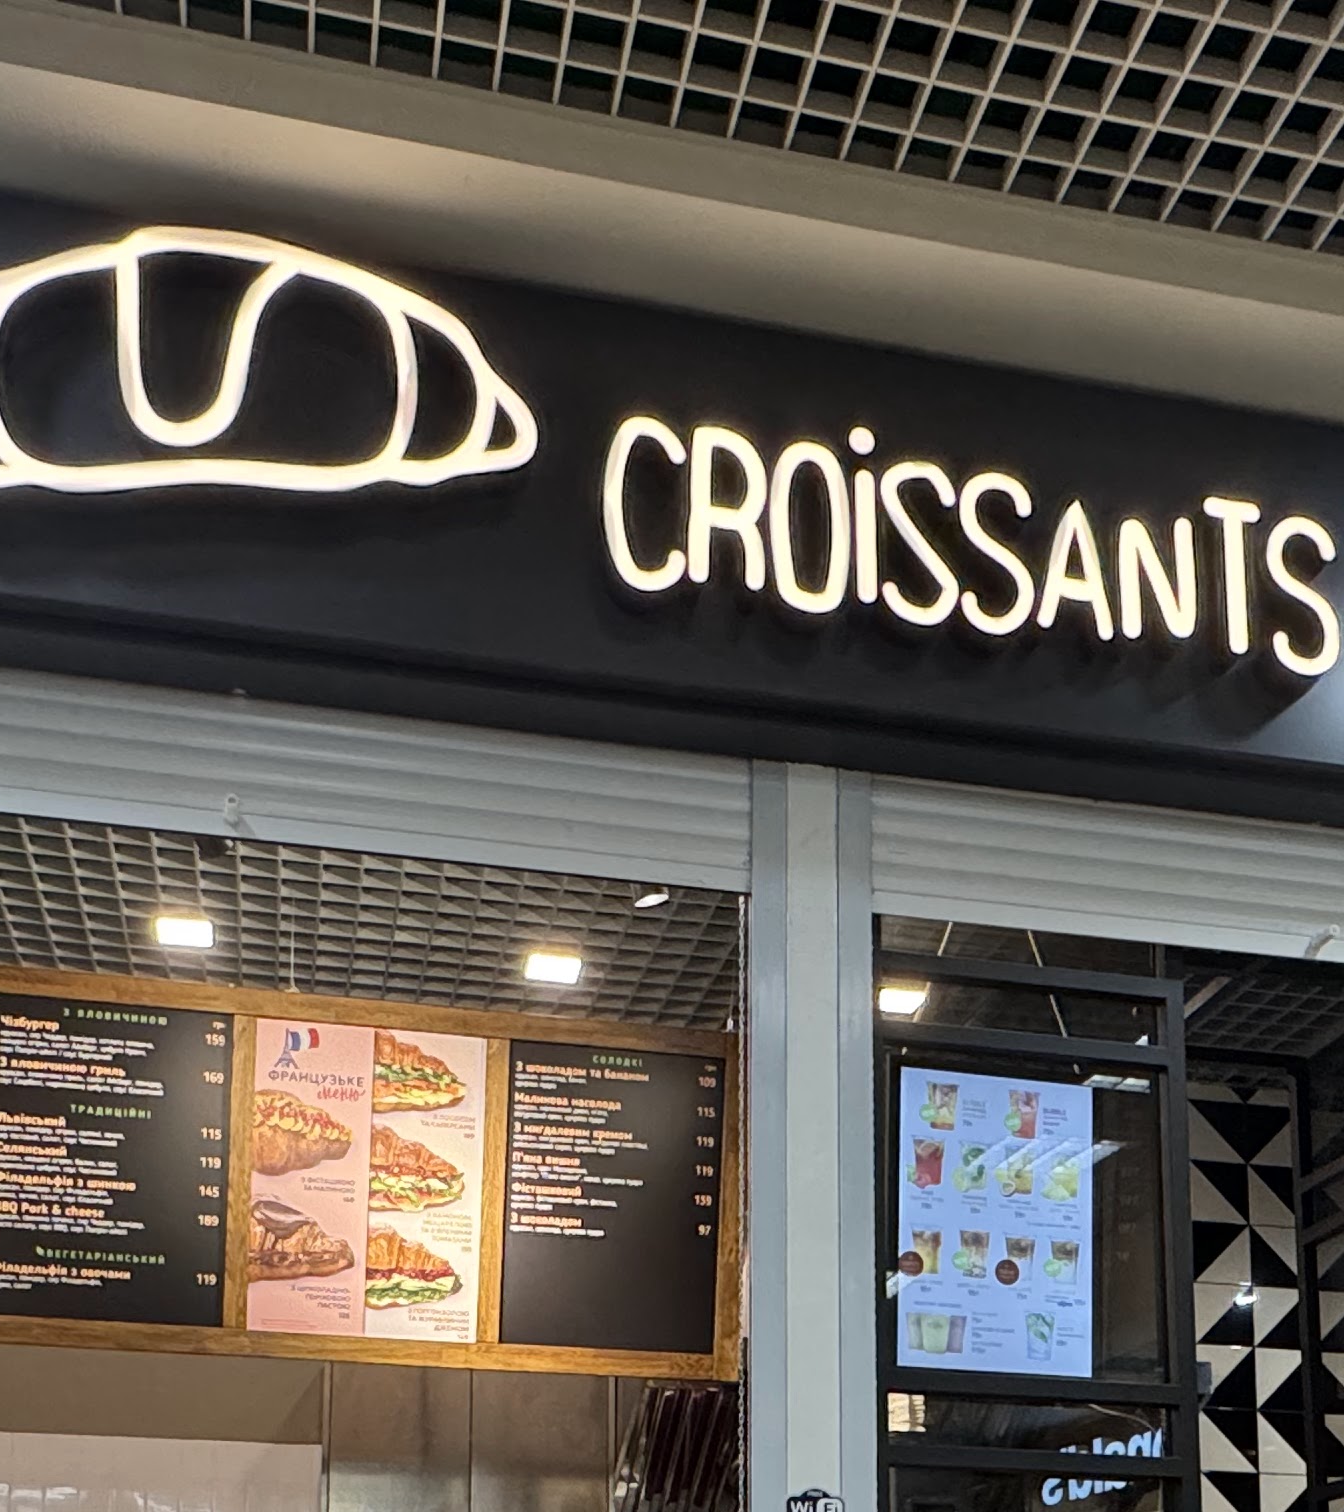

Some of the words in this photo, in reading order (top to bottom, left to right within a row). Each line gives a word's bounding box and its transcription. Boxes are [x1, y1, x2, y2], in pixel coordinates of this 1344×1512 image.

[593, 1055, 643, 1067] СОЛОДКІ
[268, 1070, 365, 1087] ФРАНЦУЗЬКЕ
[201, 1127, 222, 1140] 115
